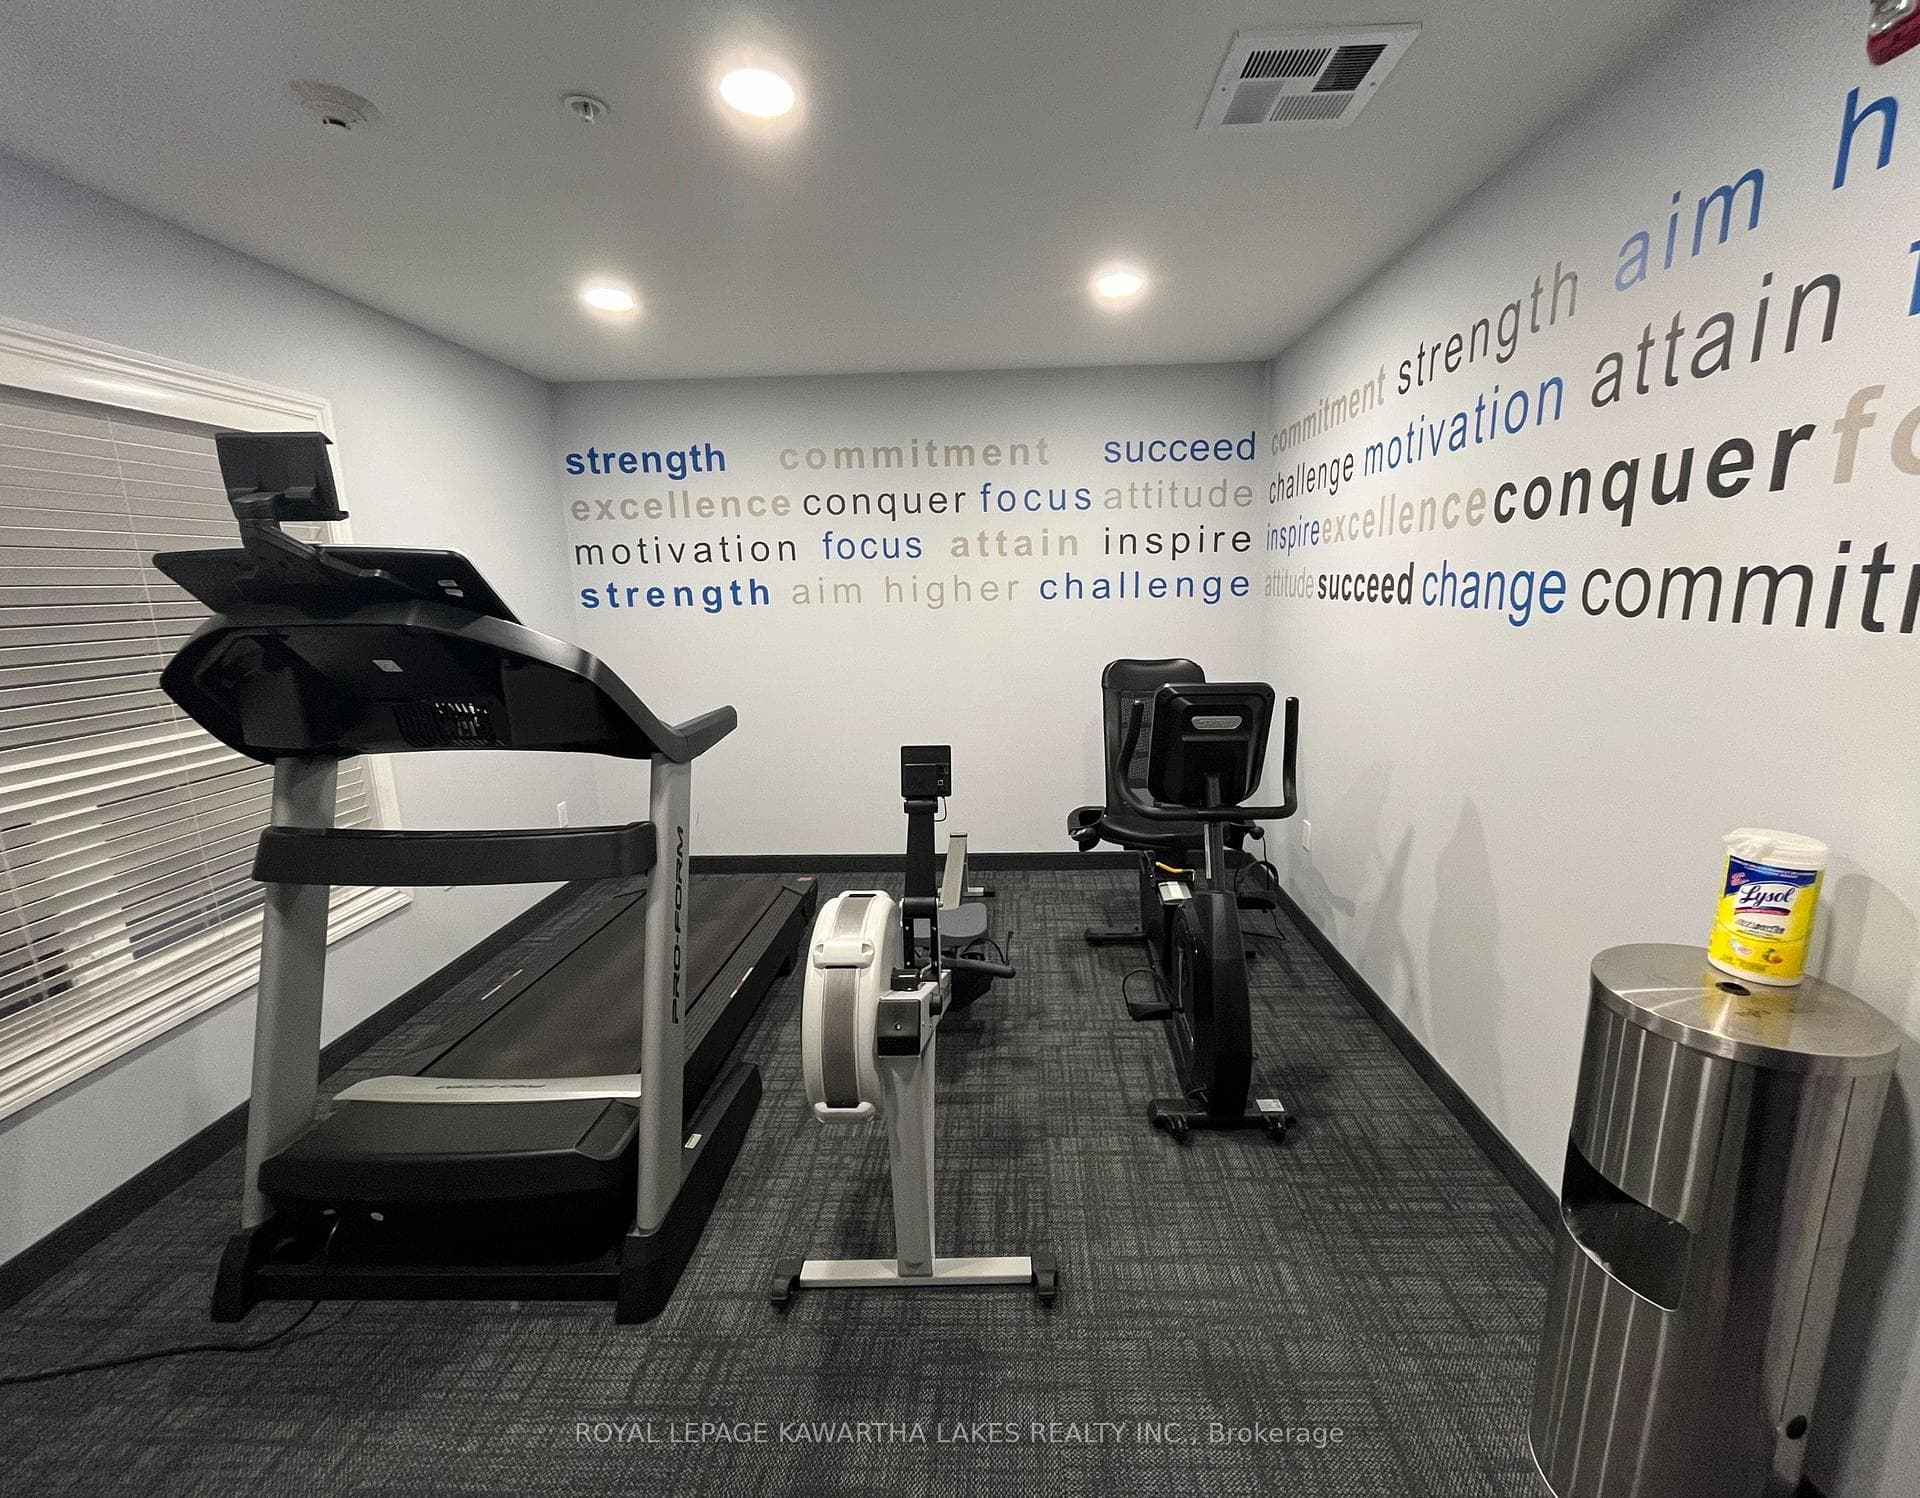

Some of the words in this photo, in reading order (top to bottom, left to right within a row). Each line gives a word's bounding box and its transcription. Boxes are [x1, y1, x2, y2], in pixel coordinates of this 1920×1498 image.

[1271, 365, 1386, 457] commitment
[1398, 261, 1578, 395] strength
[1614, 167, 1765, 293] aim
[1269, 453, 1354, 505] challenge
[1364, 376, 1564, 477] motivation
[1591, 271, 1841, 408] attain
[566, 443, 725, 480] strength
[781, 438, 1048, 469] commitment
[1105, 431, 1256, 463] succeed
[1267, 515, 1320, 556] inspire
[1322, 487, 1488, 545] excellence
[1493, 423, 1816, 527] conquer
[570, 490, 790, 521] excellence
[803, 492, 966, 521] conquer
[980, 482, 1091, 512] focus
[1104, 479, 1254, 510] attitude
[575, 534, 796, 565] motivation
[822, 530, 922, 560] focus
[951, 528, 1078, 558] attain
[1105, 525, 1251, 560] inspire
[581, 578, 769, 614] strength
[792, 577, 861, 605] aim
[885, 574, 1019, 610] higher
[1040, 571, 1249, 605] challenge
[1265, 567, 1314, 599] attitude
[1317, 562, 1414, 605] succeed
[1422, 560, 1566, 627] change
[1581, 540, 1920, 634] commit
[672, 825, 683, 1024] PRO-FORM
[1740, 885, 1795, 907] Lysol
